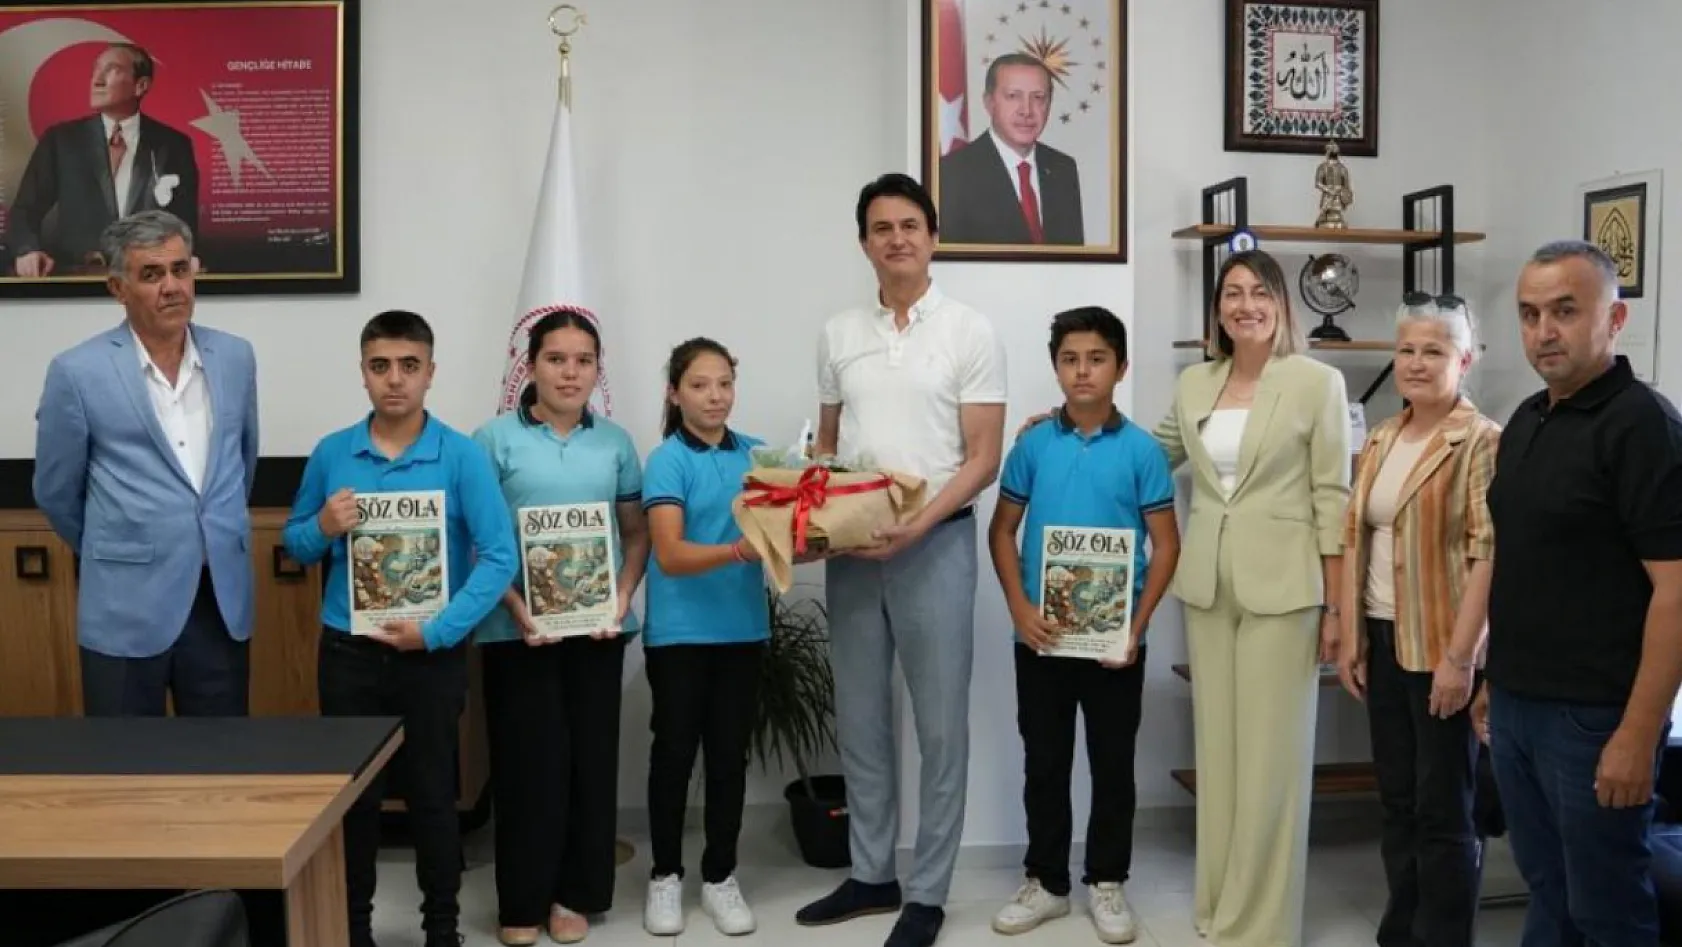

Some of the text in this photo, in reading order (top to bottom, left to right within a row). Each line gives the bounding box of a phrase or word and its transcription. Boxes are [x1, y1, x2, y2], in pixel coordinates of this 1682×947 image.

[355, 496, 439, 525] SÖZ OLA
[525, 507, 605, 537] SÖZ OLA
[1047, 529, 1129, 555] SÖZ OLA
